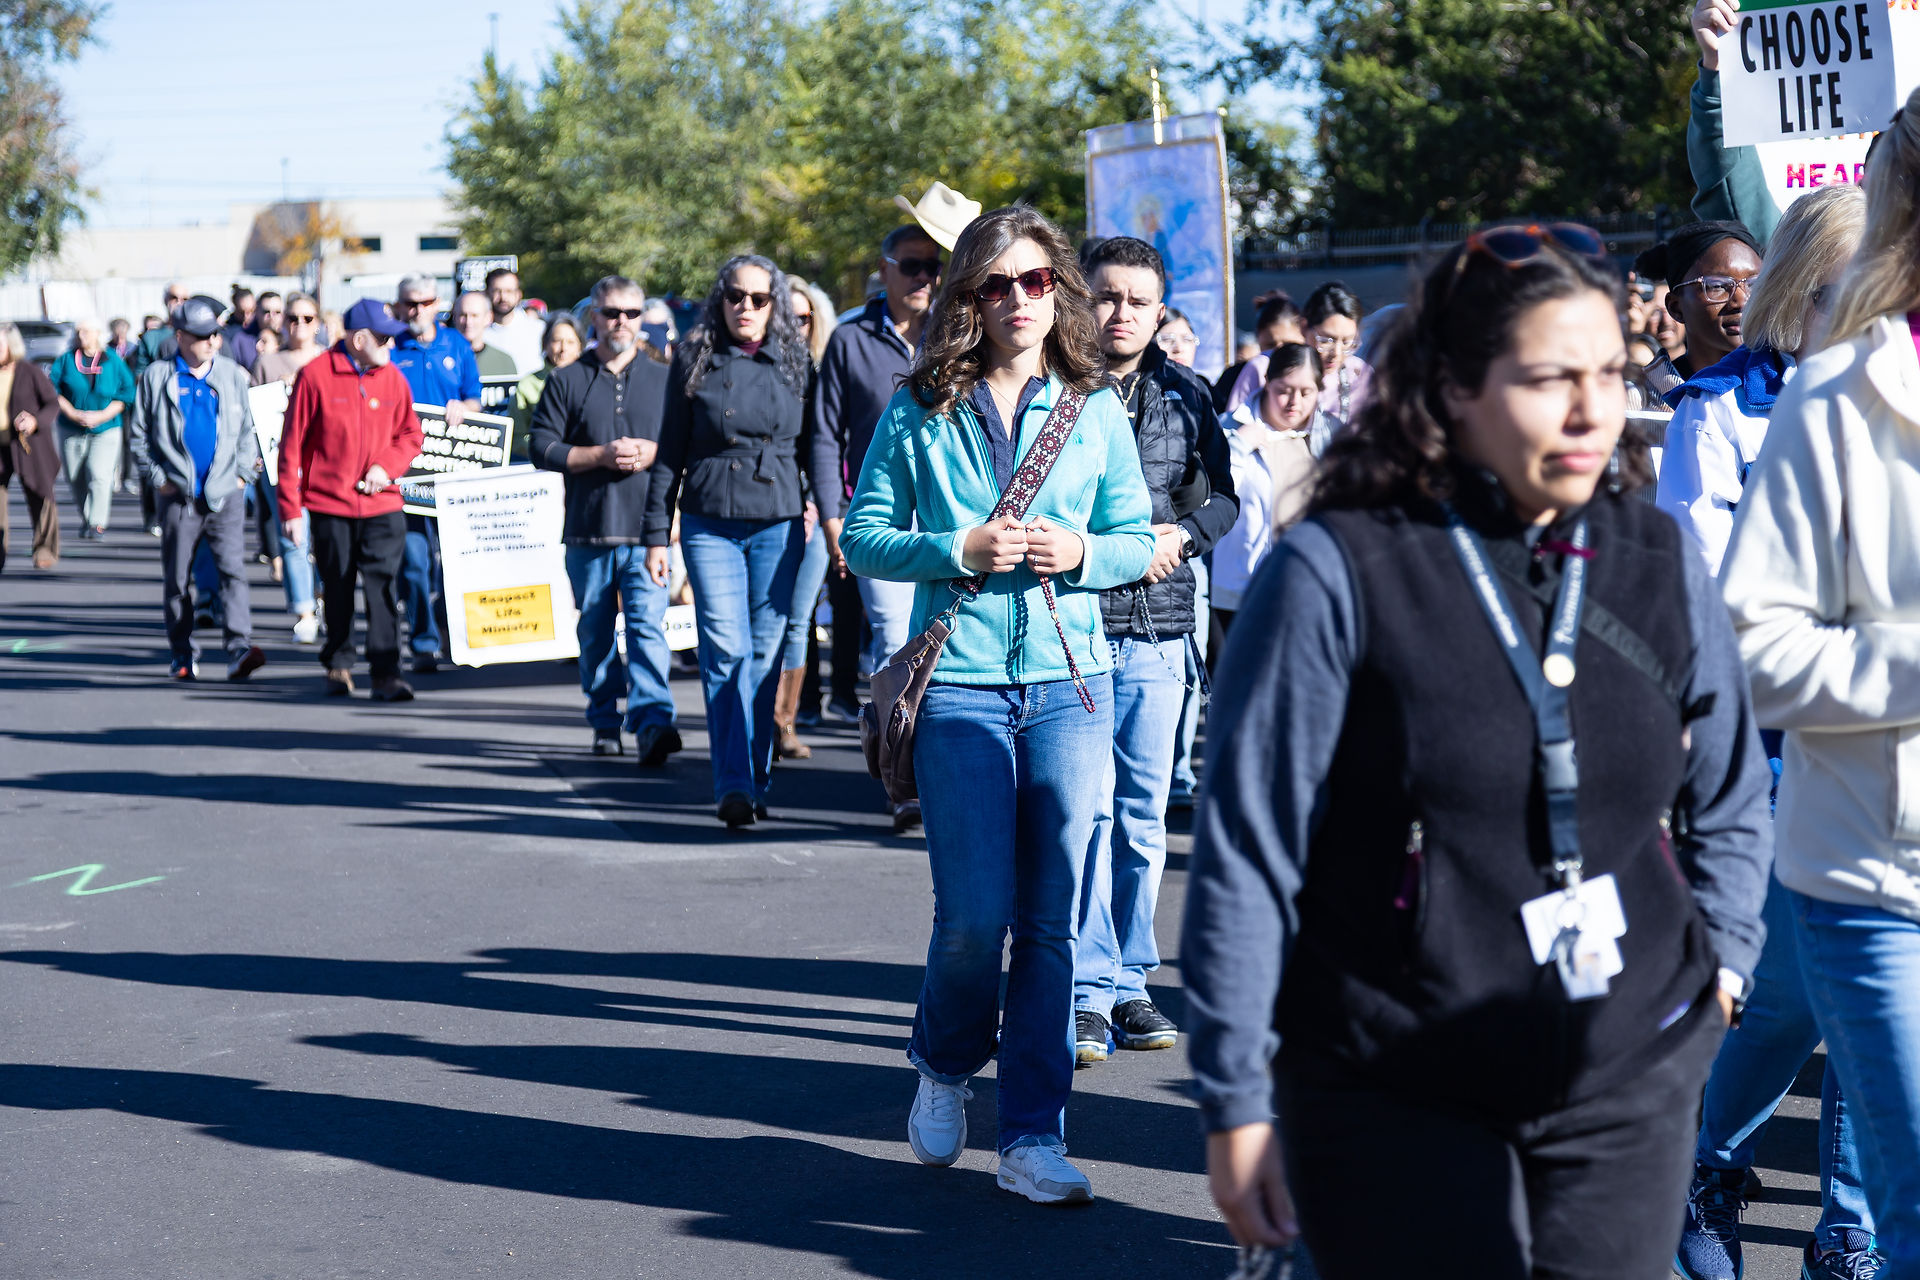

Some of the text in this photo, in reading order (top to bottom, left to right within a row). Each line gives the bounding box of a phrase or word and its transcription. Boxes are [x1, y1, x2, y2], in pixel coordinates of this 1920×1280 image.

[1740, 3, 1873, 73] CHOOSE
[1778, 71, 1844, 134] LIFE
[446, 424, 501, 445] ABOUT
[452, 441, 503, 463] AFTER
[410, 454, 483, 473] BORTION
[447, 494, 487, 506] Saint
[493, 487, 549, 502] Joseph
[479, 591, 536, 605] Respect
[496, 608, 522, 618] Life
[481, 622, 539, 635] Ministry
